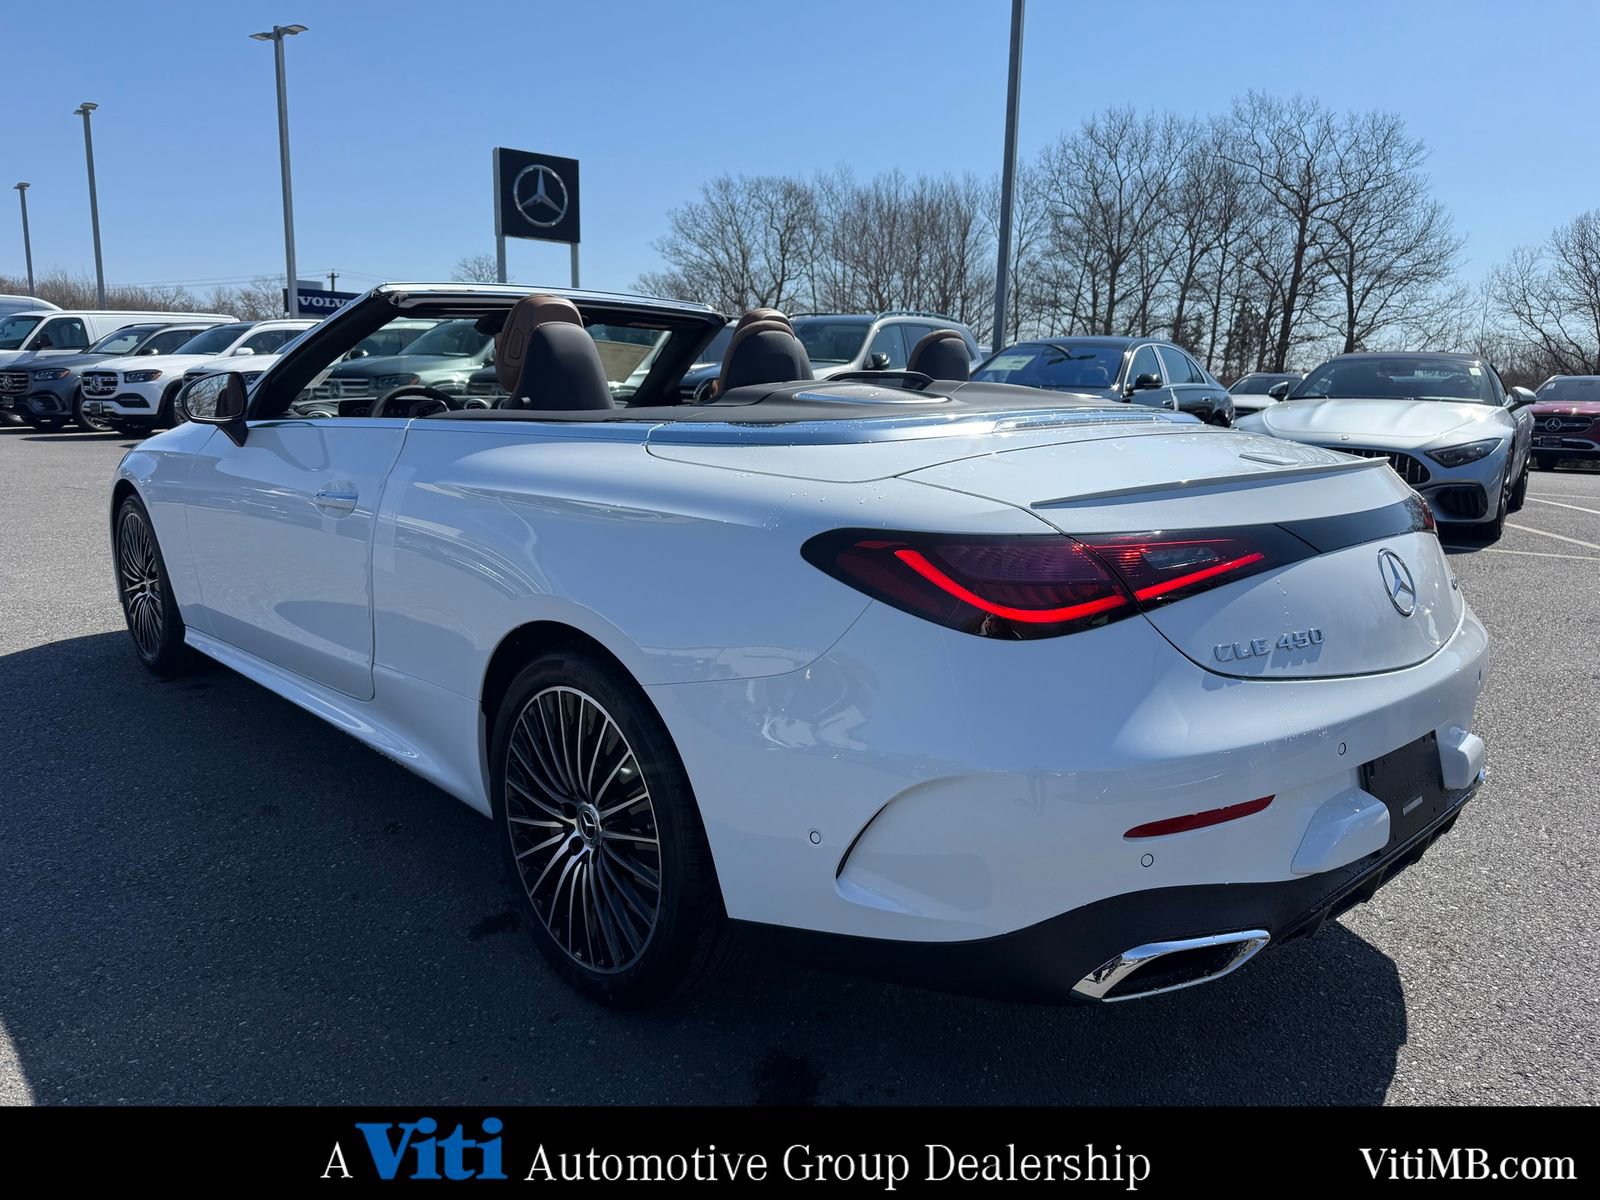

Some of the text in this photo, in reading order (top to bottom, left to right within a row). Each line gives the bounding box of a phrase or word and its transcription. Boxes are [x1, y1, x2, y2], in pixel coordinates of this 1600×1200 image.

[297, 295, 352, 308] VOLV
[1213, 628, 1325, 663] CLE 450
